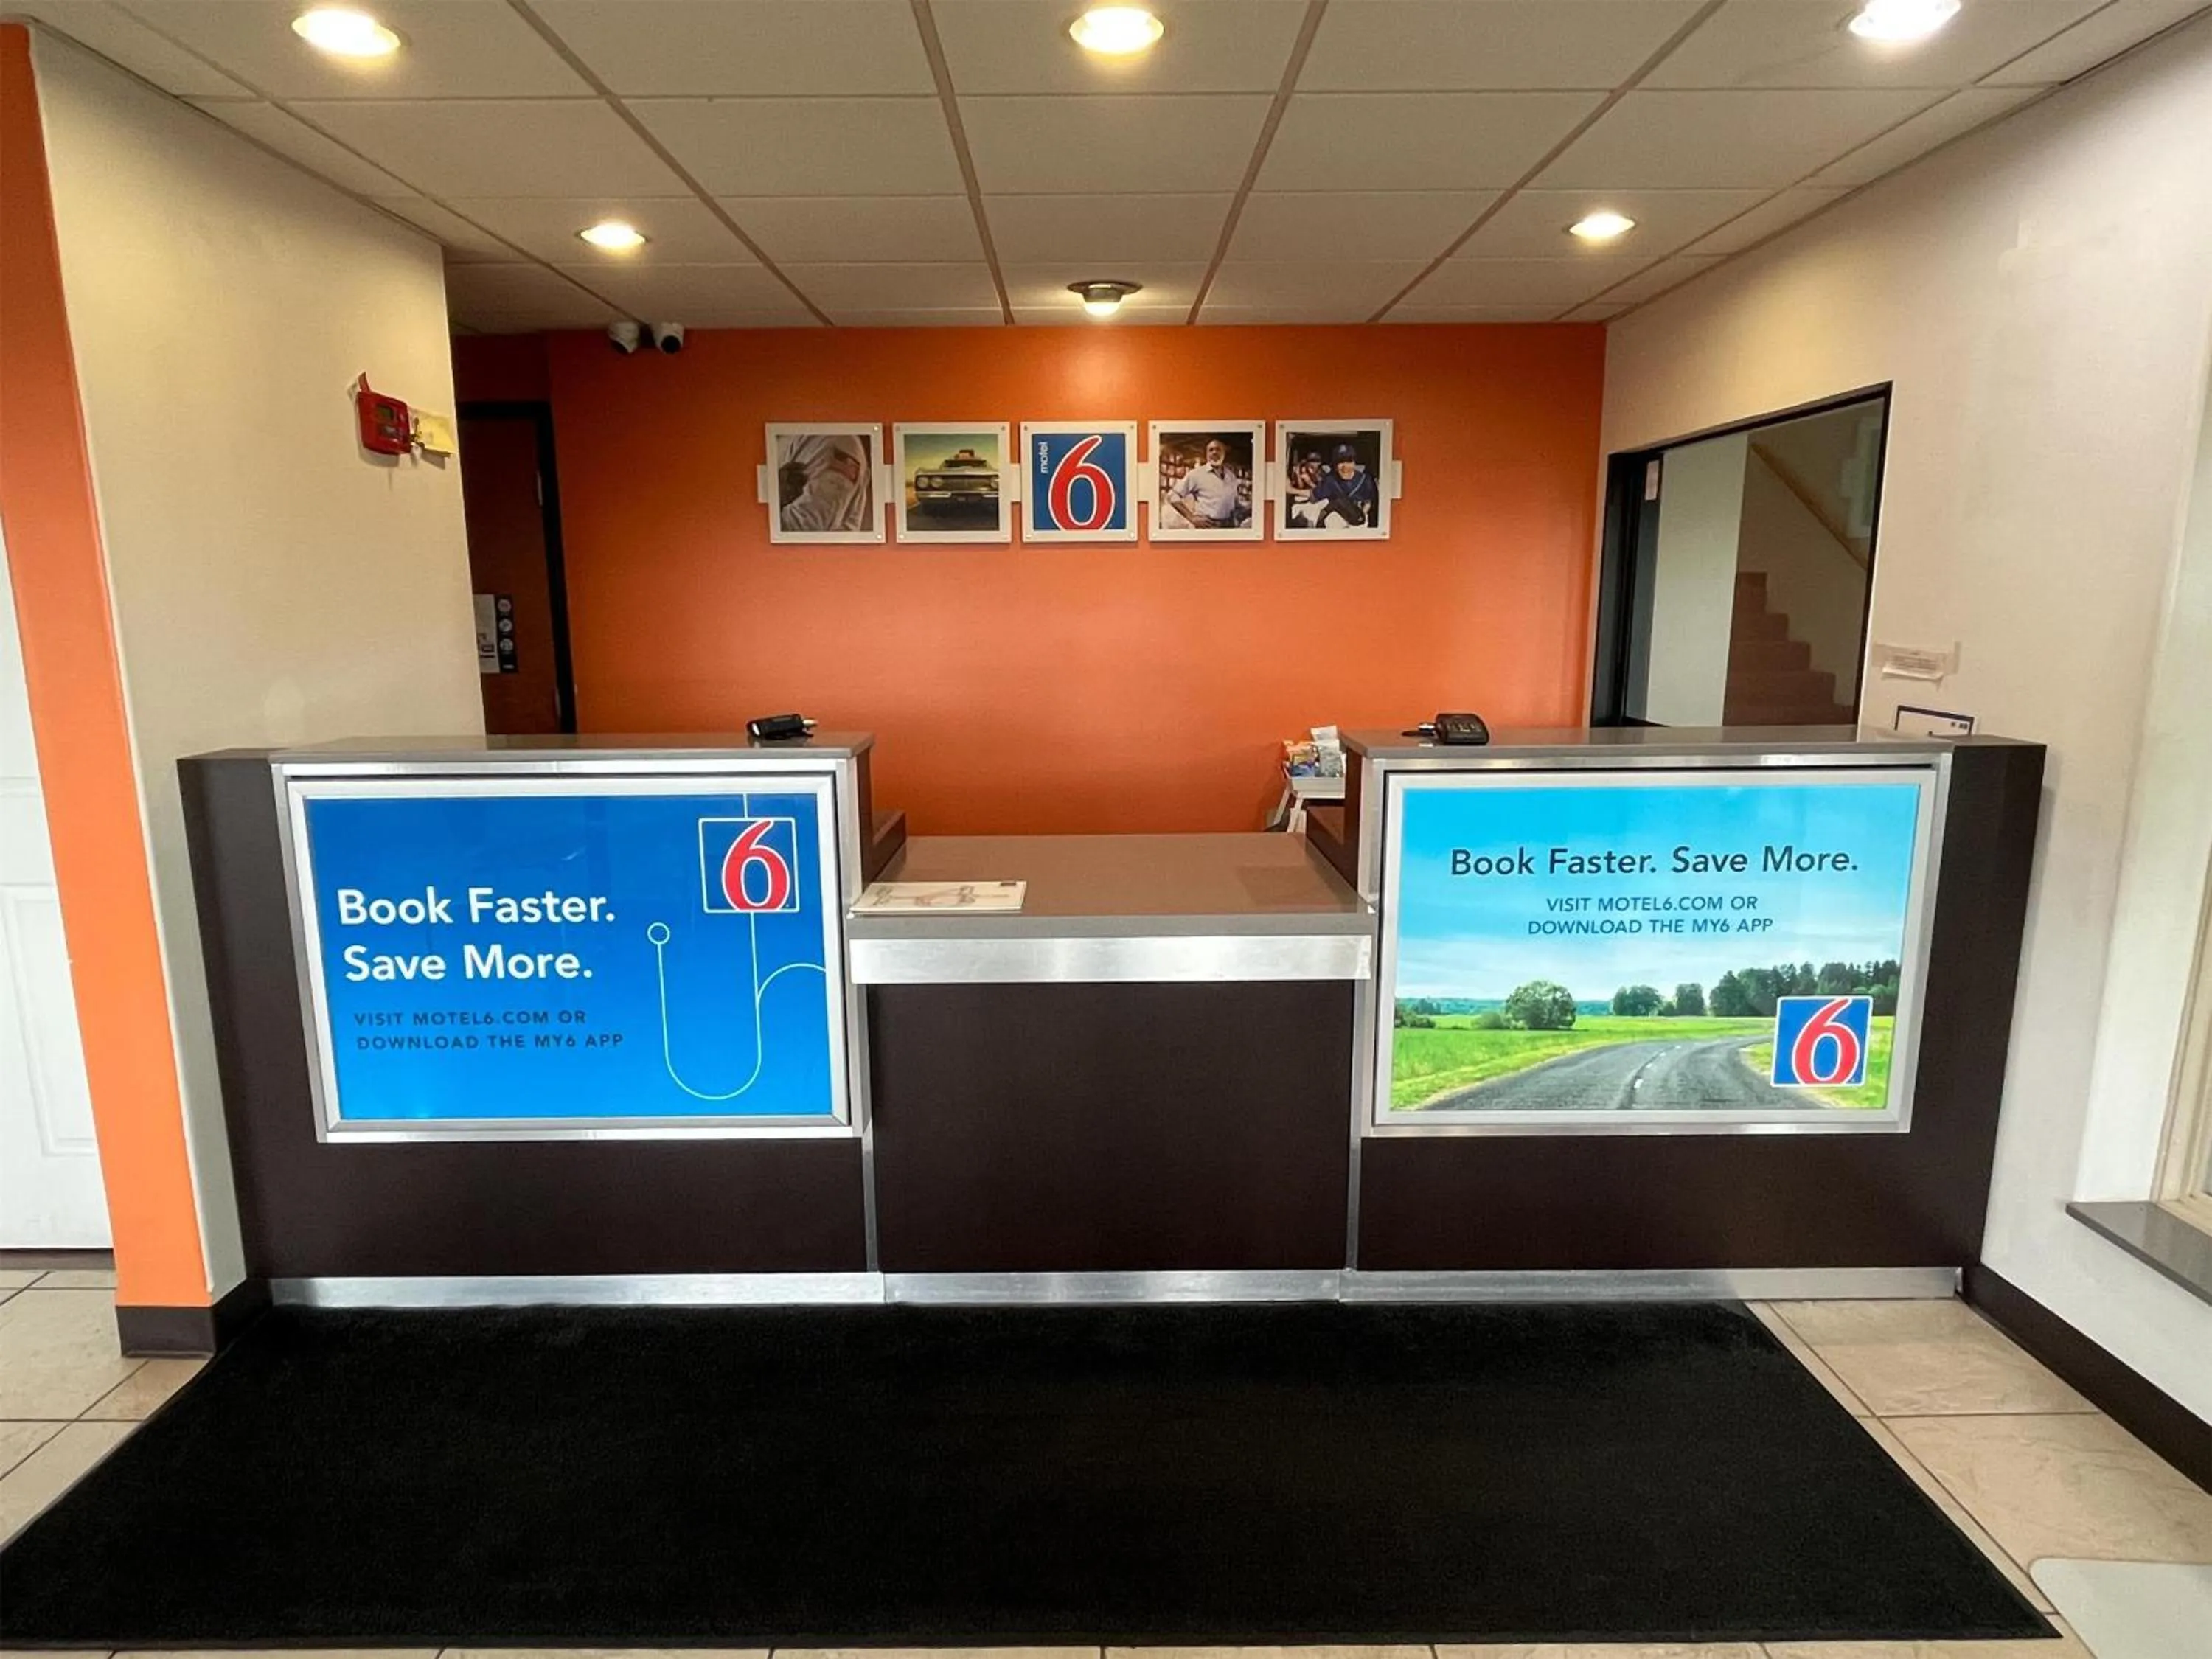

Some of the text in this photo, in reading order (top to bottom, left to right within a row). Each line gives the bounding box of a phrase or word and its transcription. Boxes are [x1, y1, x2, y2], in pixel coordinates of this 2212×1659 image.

[1038, 434, 1116, 531] motel 6
[722, 818, 790, 912] 6
[1450, 845, 1860, 876] Book Faster. Save More.
[337, 886, 616, 925] Book Faster.
[1546, 896, 1759, 912] VISIT MOTEL6.COM OR
[1528, 918, 1774, 936] DOWNLOAD THE MY6 APP
[343, 944, 594, 982] Save More.
[353, 1009, 587, 1026] VISIT MOTEL6.COM OR
[357, 1033, 624, 1051] DOWNLOAD THE MY6 APP
[1792, 996, 1860, 1086] 6
